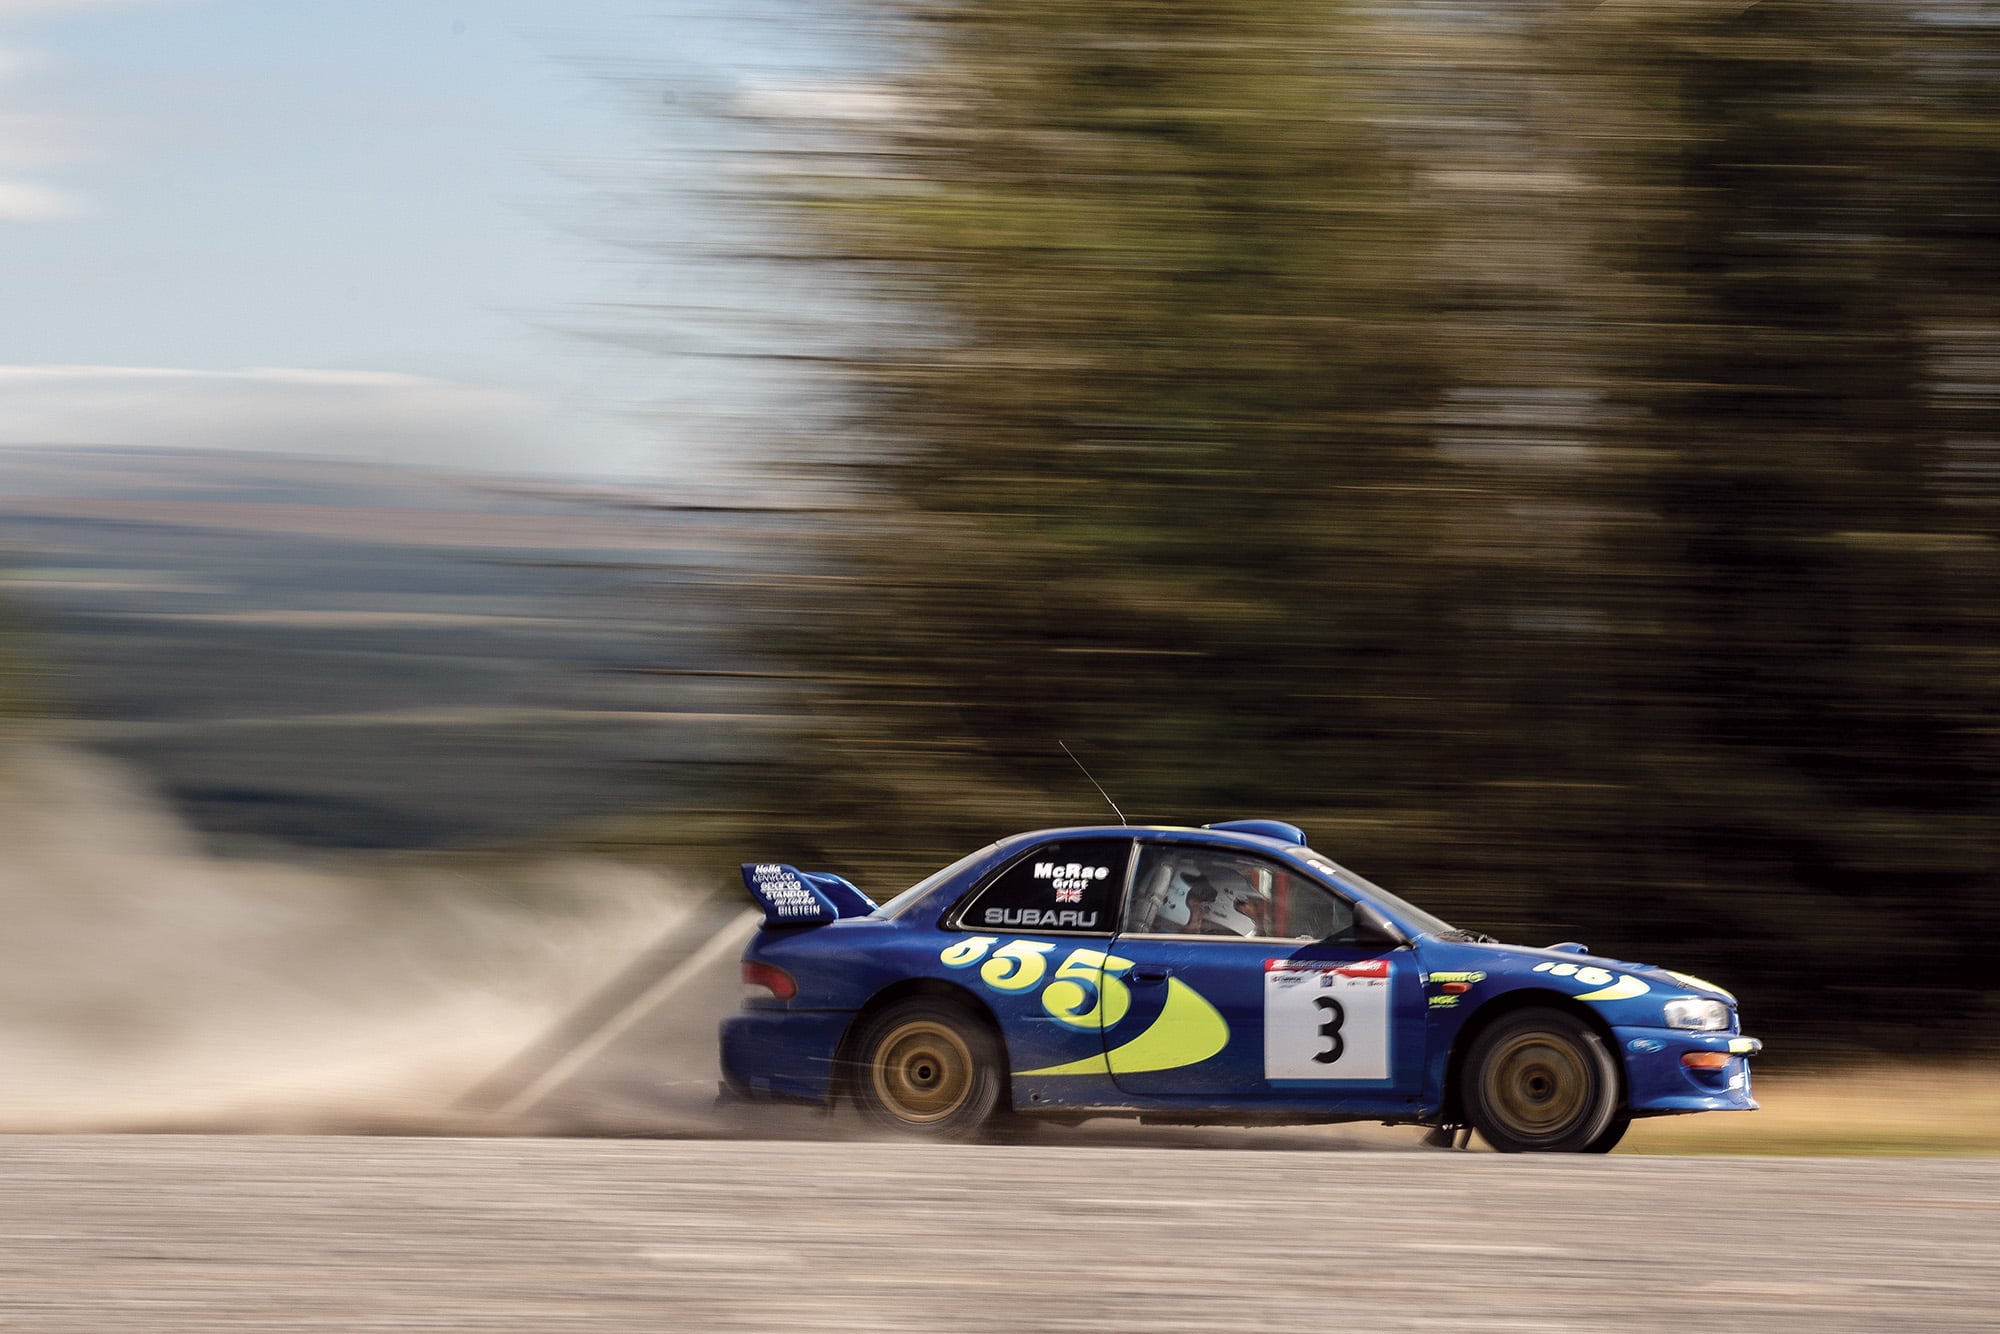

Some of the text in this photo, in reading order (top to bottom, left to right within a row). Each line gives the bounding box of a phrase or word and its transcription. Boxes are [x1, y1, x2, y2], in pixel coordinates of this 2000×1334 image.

[1034, 862, 1110, 880] McRae
[1052, 878, 1089, 890] Grist
[766, 890, 810, 900] STANDOX
[778, 904, 820, 916] BILSTEIN
[984, 908, 1098, 927] SUBARU
[940, 936, 1136, 1033] 555
[1428, 995, 1460, 1005] NGK
[1311, 995, 1345, 1064] 3
